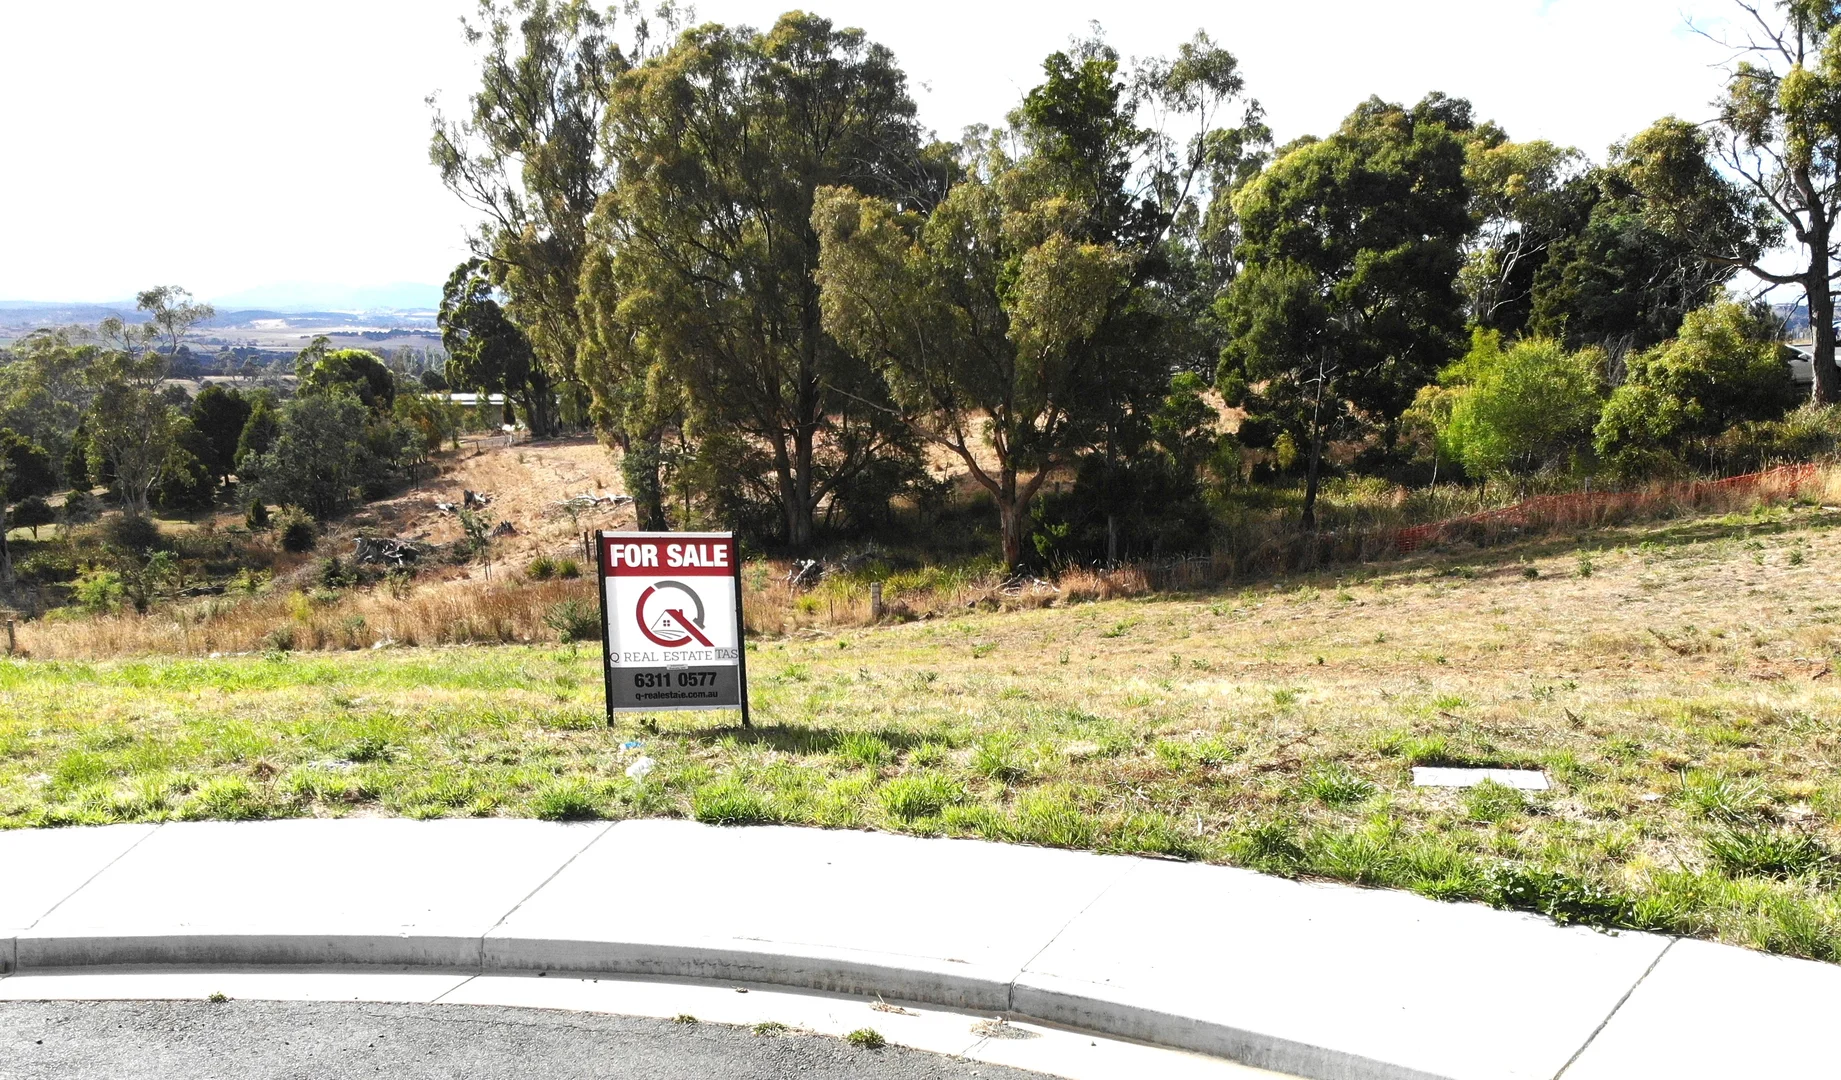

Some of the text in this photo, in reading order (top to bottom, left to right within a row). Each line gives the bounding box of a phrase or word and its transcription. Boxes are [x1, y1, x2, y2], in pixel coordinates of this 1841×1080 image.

[610, 543, 729, 567] FOR SALE
[610, 649, 738, 663] Q REAL ESTATE TAS
[634, 672, 717, 688] 6311 0577
